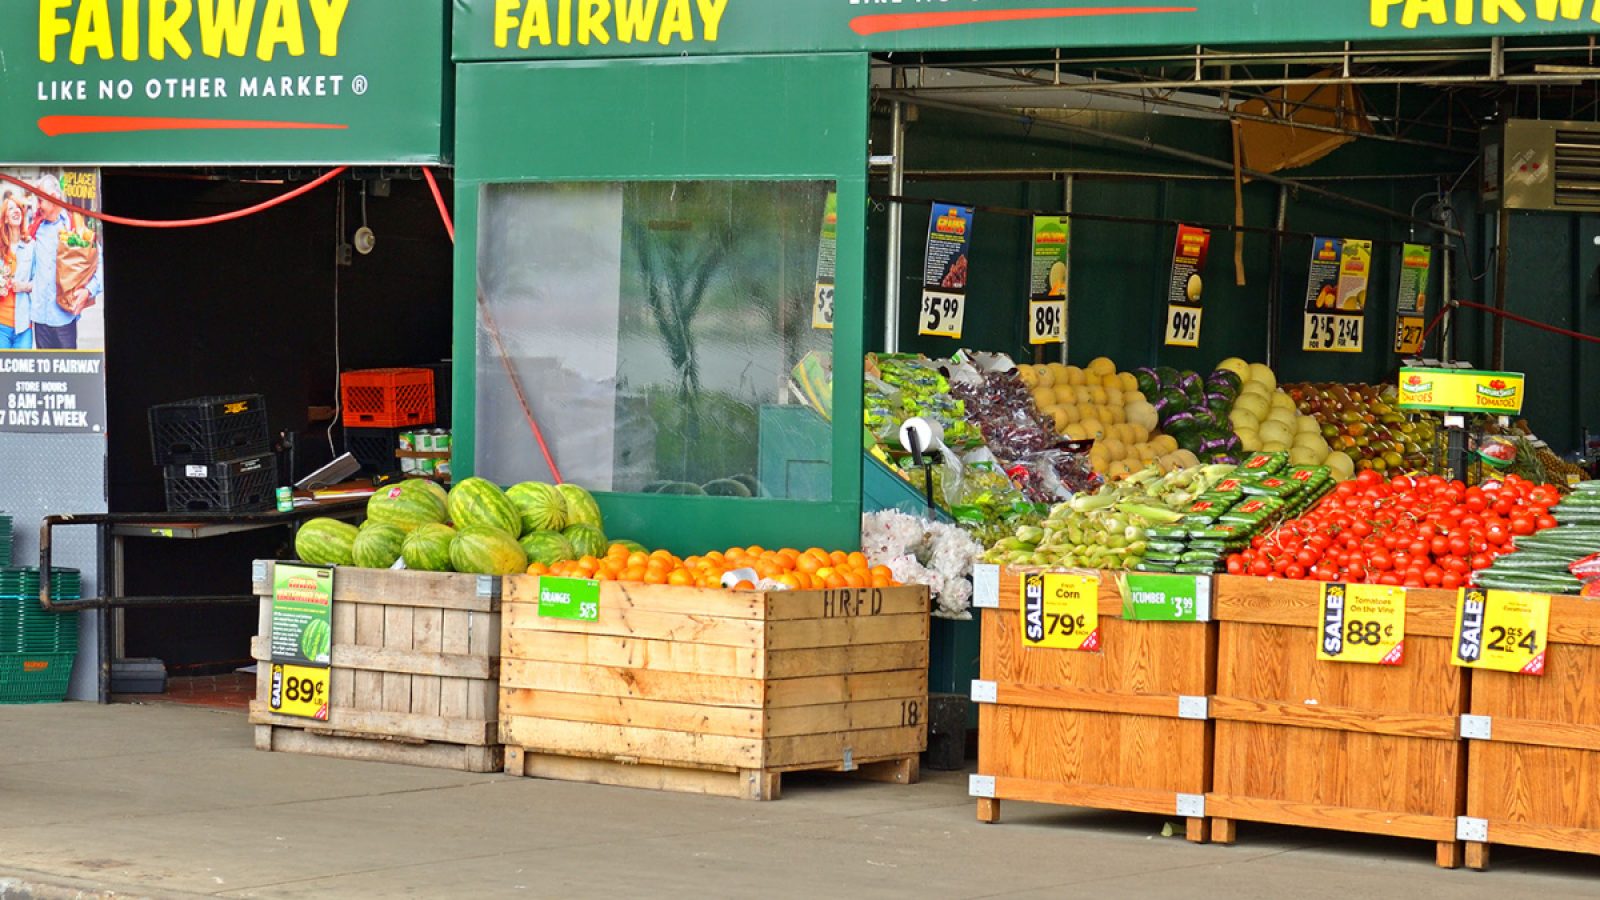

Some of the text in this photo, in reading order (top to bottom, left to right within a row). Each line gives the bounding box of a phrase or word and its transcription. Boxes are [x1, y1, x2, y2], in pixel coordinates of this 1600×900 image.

[38, 0, 349, 64] FAIRWAY
[493, 0, 728, 48] FAIRWAY
[38, 80, 87, 101] LIKE
[99, 79, 133, 99] NO
[145, 77, 228, 98] OTHER
[239, 75, 344, 97] MARKET
[1311, 316, 1319, 339] 2
[36, 359, 50, 373] TO
[53, 359, 100, 374] FAIRWAY
[15, 381, 68, 392] STORE HOURS
[0, 410, 88, 427] 7 DAYS A WEEK
[1056, 588, 1080, 600] Corn
[1355, 596, 1391, 605] Tomatoes
[1027, 584, 1043, 639] SALE
[1378, 606, 1395, 614] Vine
[1324, 595, 1343, 652] SALE
[1460, 599, 1484, 658] SALE
[1487, 625, 1506, 651] 2
[1505, 627, 1516, 652] FOR
[901, 700, 918, 728] 18
